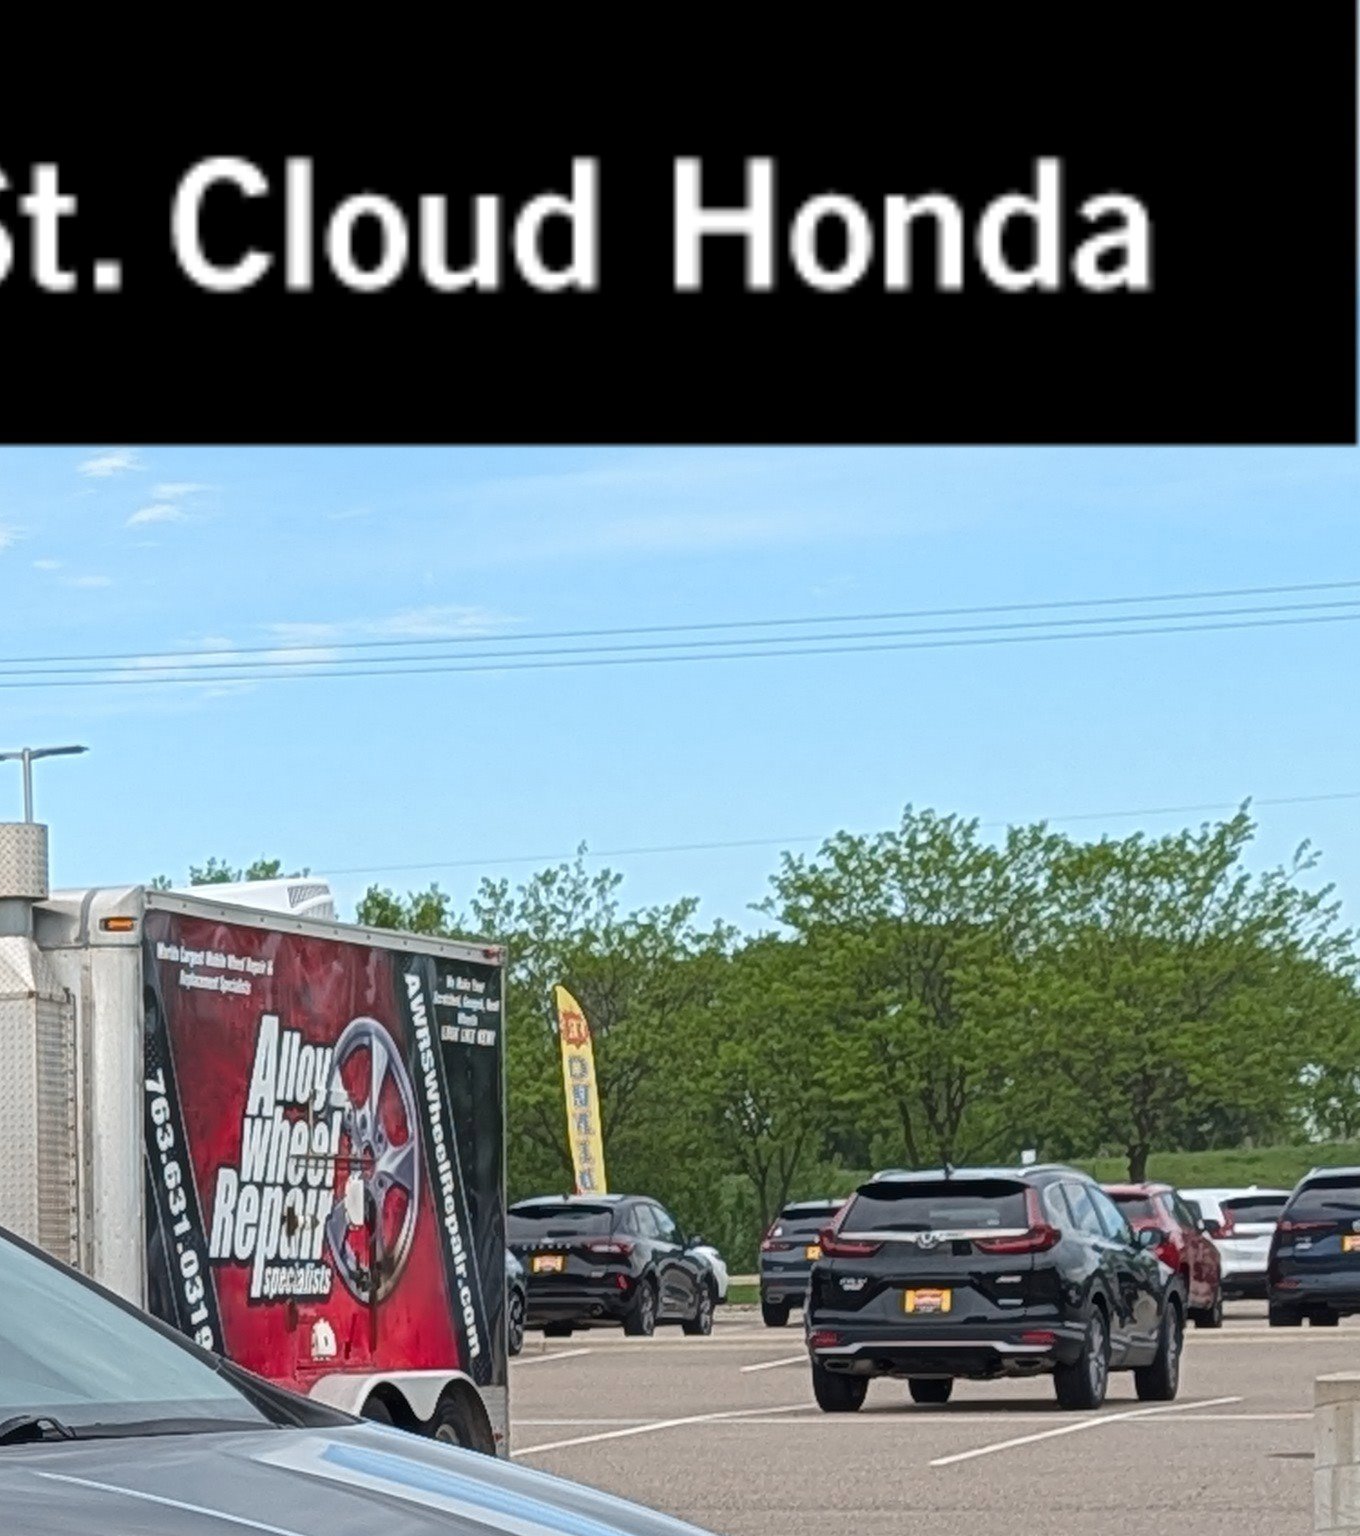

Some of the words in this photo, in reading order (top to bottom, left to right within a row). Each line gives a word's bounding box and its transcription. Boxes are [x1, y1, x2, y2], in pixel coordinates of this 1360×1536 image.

[246, 1014, 334, 1116] Alloy
[241, 1105, 345, 1187] wheel
[145, 1067, 213, 1352] 763.631.0319
[209, 1167, 333, 1298] Repair
